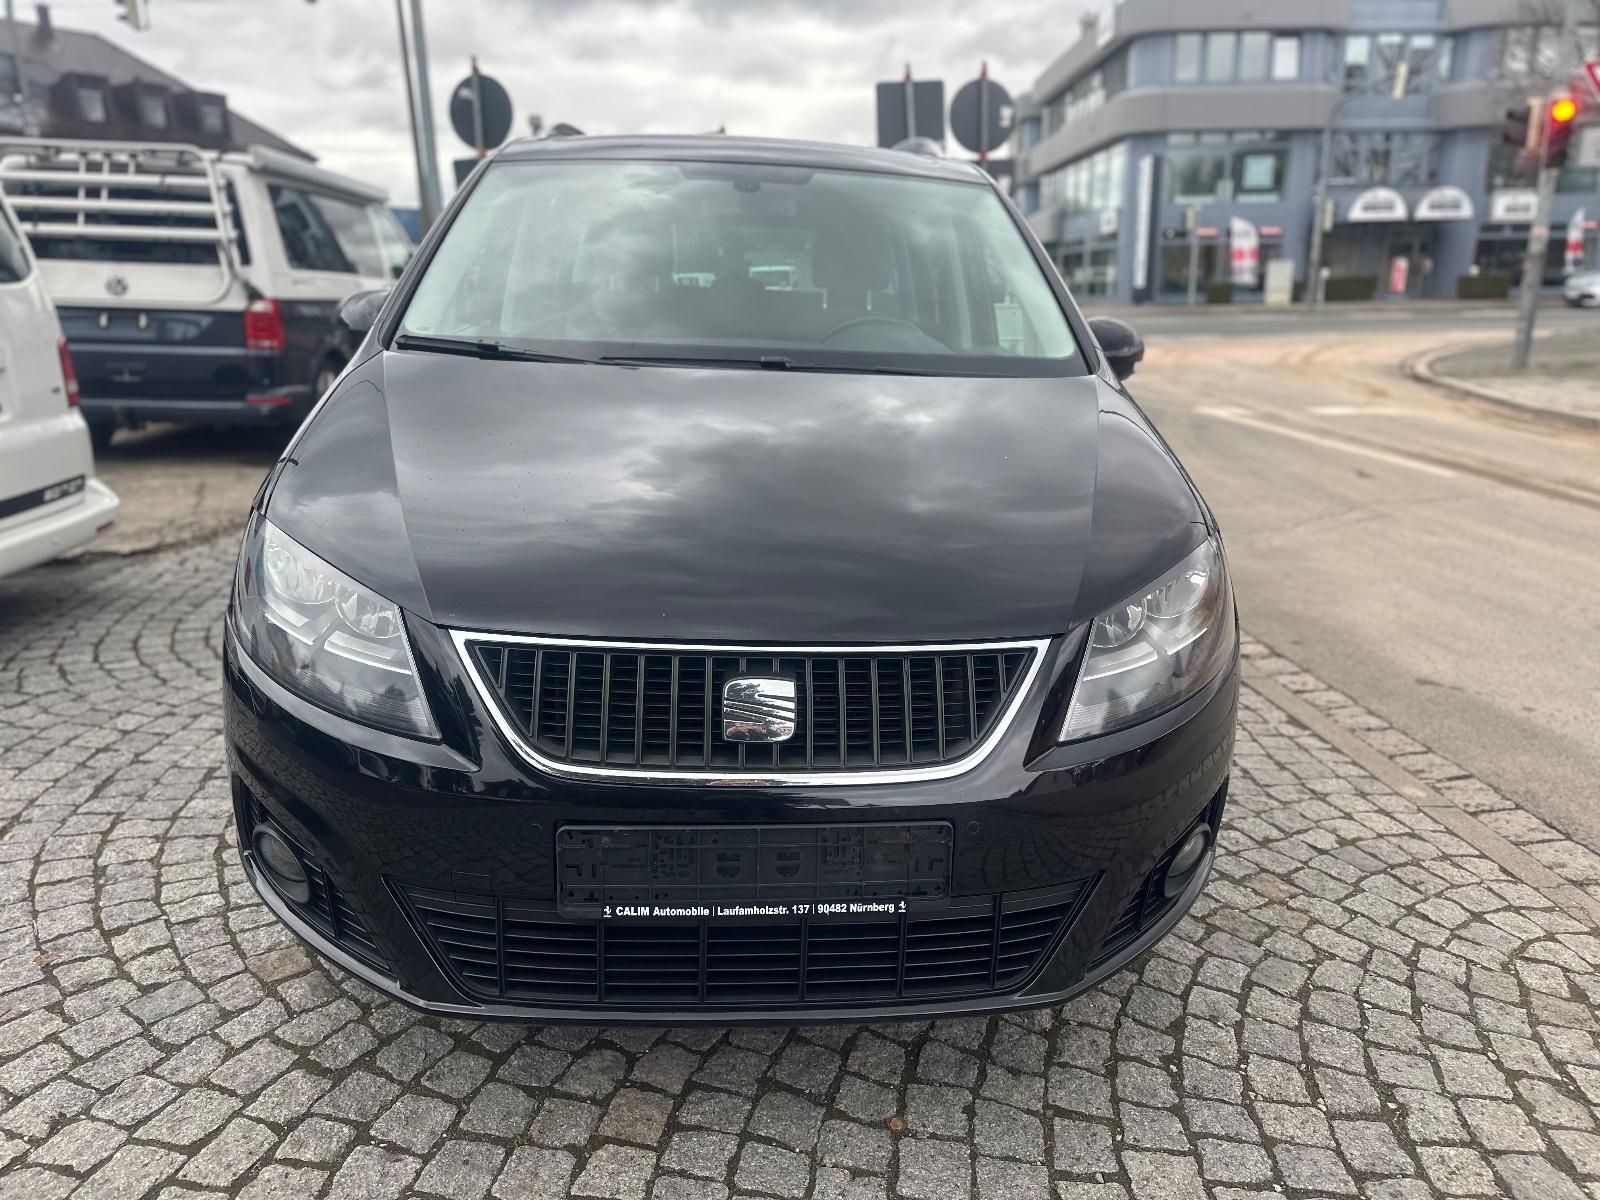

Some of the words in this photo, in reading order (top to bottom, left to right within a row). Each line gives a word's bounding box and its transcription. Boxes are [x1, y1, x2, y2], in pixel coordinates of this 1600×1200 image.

[615, 906, 650, 917] CALIM
[653, 906, 710, 917] Automobile
[717, 905, 789, 916] Laufamholzstr.
[792, 904, 811, 914] 137
[817, 903, 848, 914] 90482
[849, 902, 895, 914] Nürnberg
